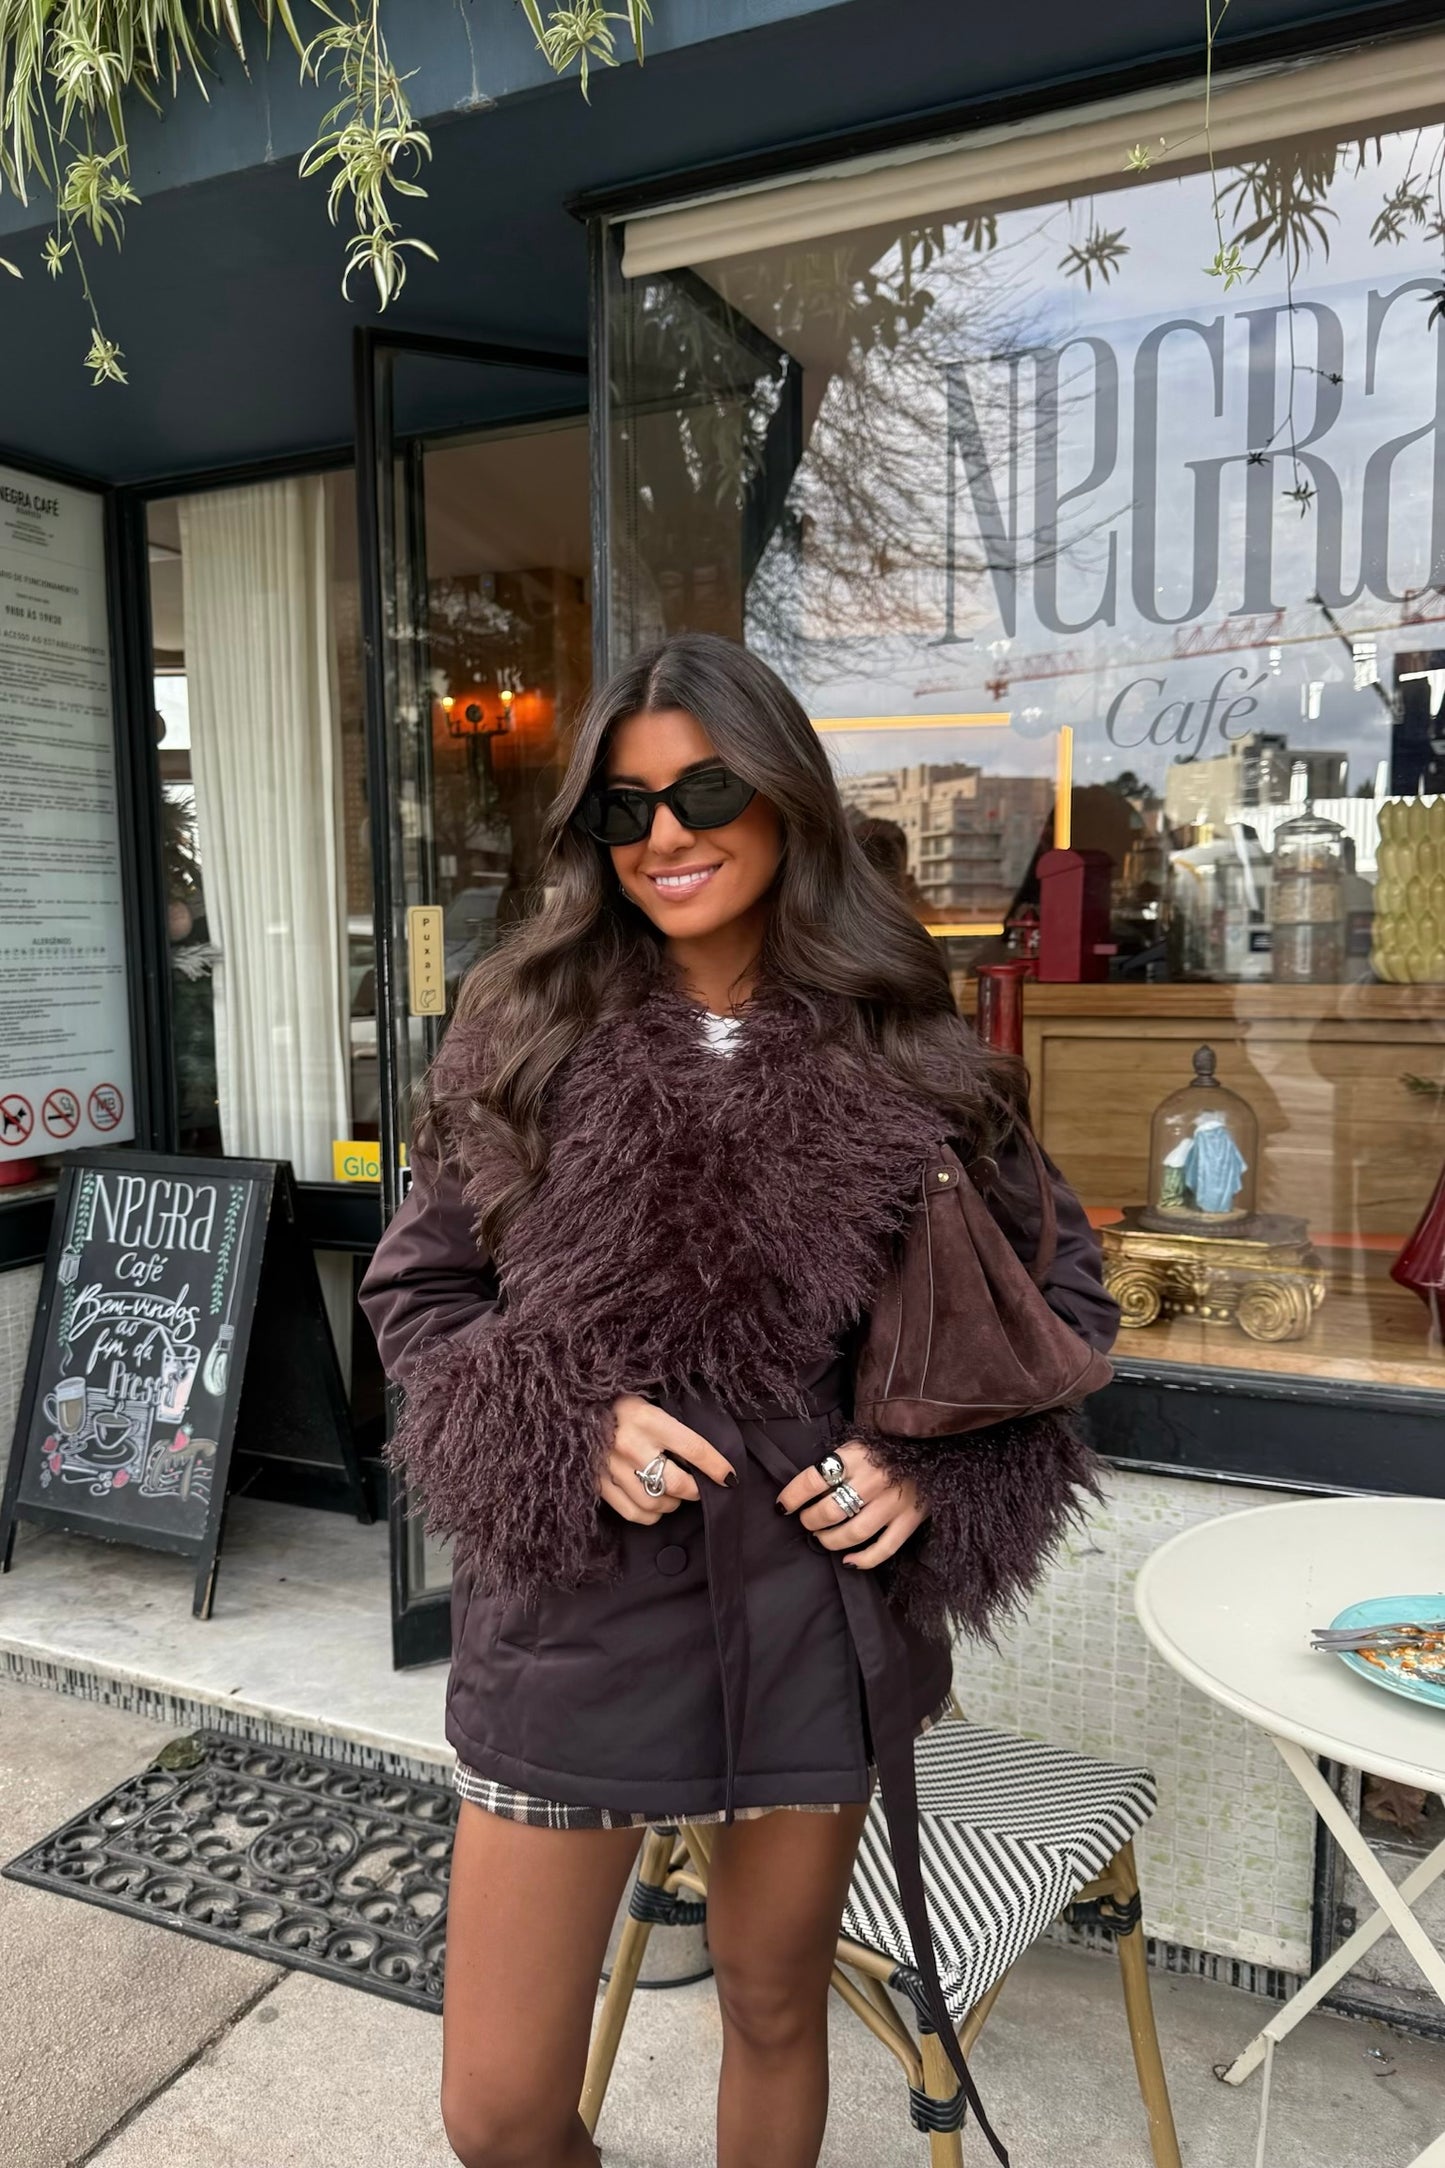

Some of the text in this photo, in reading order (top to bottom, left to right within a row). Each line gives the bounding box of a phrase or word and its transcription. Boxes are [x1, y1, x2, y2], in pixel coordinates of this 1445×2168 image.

[34, 496, 59, 517] CAFÉ
[1105, 666, 1269, 764] Café
[115, 1252, 168, 1287] Café
[69, 1283, 201, 1344] Bem-vindos
[115, 1320, 142, 1335] ao
[132, 1326, 160, 1367] da
